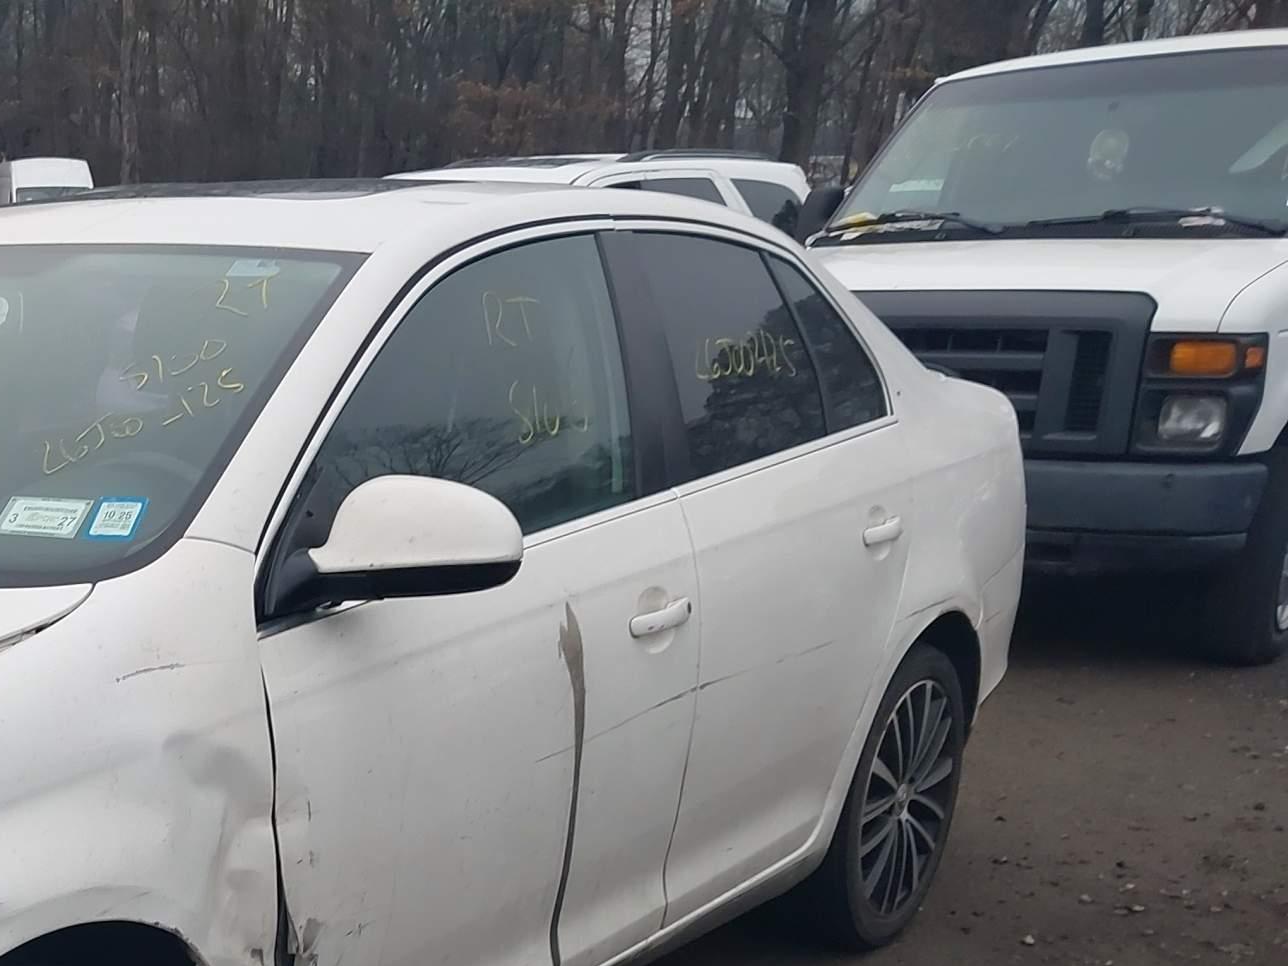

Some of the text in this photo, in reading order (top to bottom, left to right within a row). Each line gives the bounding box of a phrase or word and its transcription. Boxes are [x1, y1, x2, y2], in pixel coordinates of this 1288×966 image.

[482, 290, 541, 346] RT
[8, 512, 20, 524] 3
[57, 515, 77, 528] 27
[103, 510, 133, 521] 10 25
